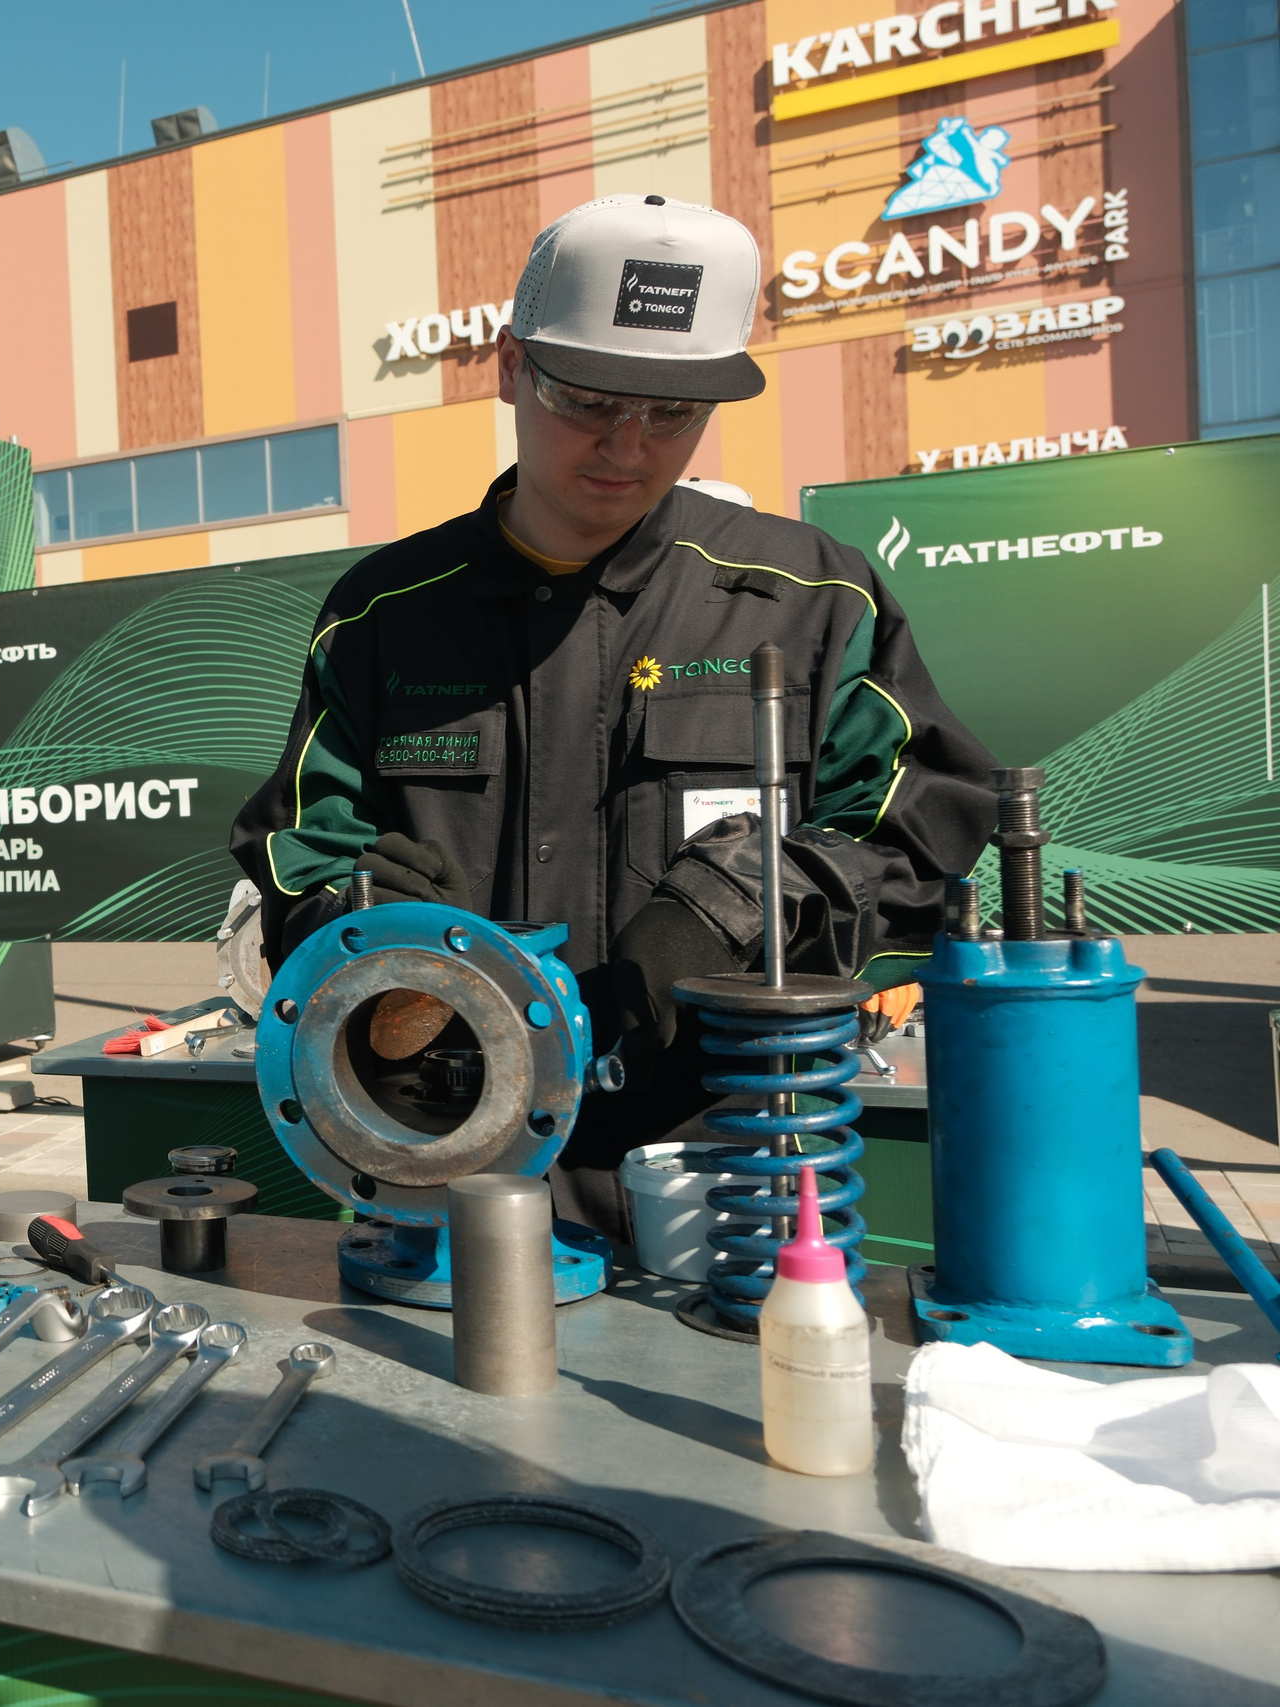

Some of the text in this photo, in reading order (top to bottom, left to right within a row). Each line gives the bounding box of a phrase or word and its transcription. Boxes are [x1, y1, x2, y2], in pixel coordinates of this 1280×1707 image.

[1103, 188, 1130, 262] PARK
[781, 196, 1096, 299] SCANDY
[638, 285, 694, 298] TATNEFT
[384, 299, 515, 362] ХОЧУ
[917, 425, 1129, 474] У ПАЛЫЧА
[916, 526, 1163, 568] ТАТНЕФТЬ
[667, 657, 752, 680] TANEC
[403, 684, 487, 696] TATNEFT
[379, 749, 477, 763] 8-800-100-41-12
[380, 735, 479, 748] ГОРЯЧАЯ ЛИНИЯ
